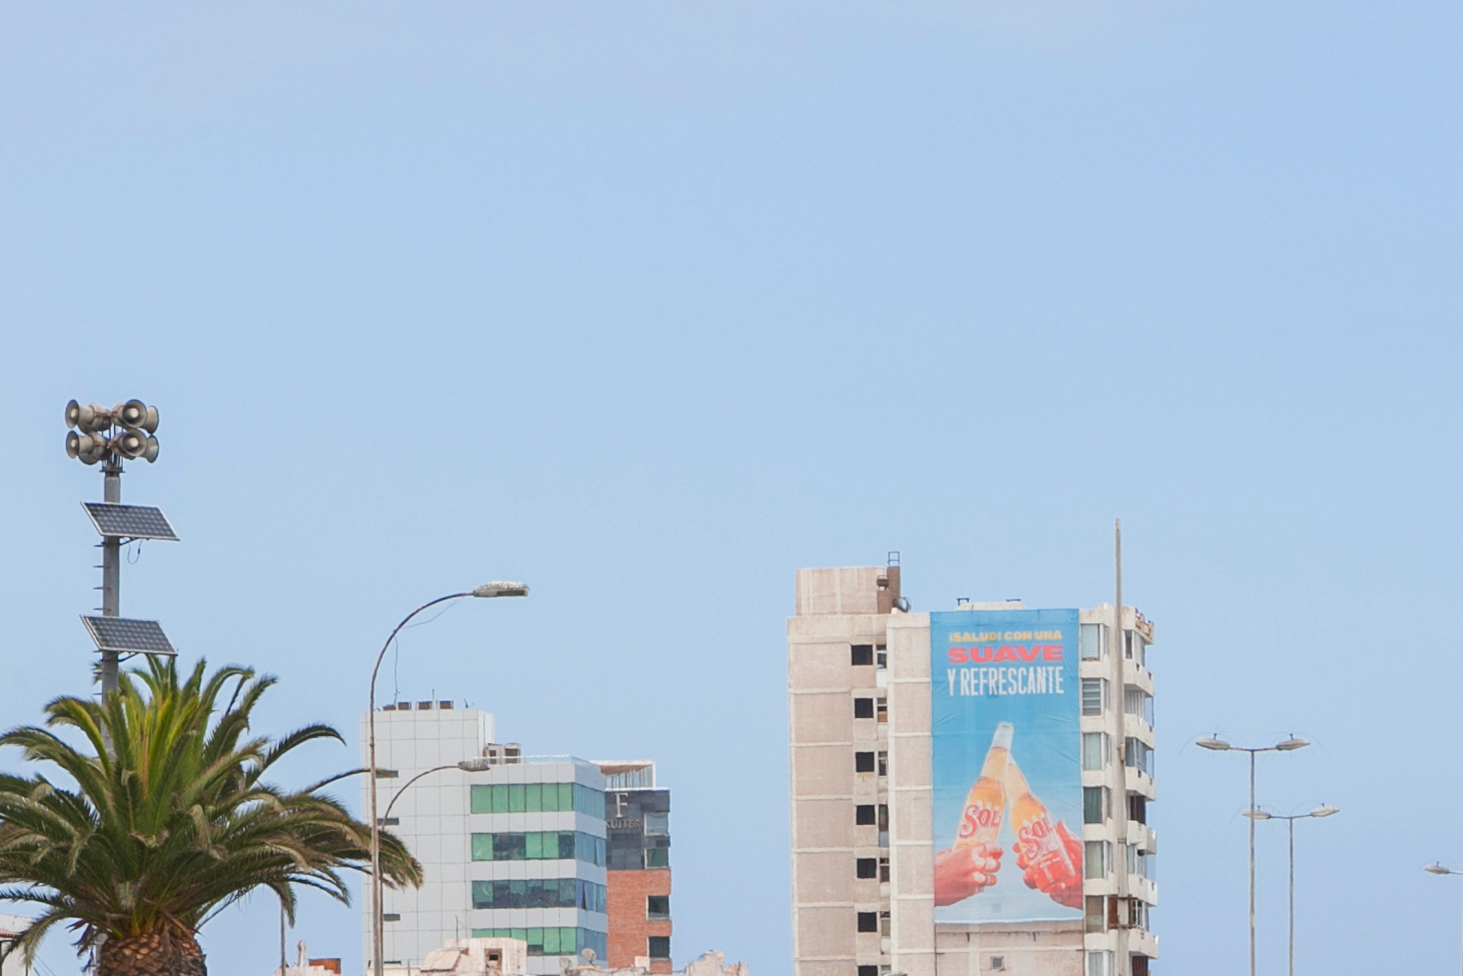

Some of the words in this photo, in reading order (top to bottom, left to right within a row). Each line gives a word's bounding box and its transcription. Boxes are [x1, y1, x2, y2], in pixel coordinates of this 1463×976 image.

[1004, 631, 1032, 640] CON
[1034, 631, 1063, 640] UNA
[948, 645, 1063, 664] SUAVE
[947, 668, 956, 696] Y
[960, 666, 1064, 696] REFRESCANTE
[614, 792, 628, 817] F
